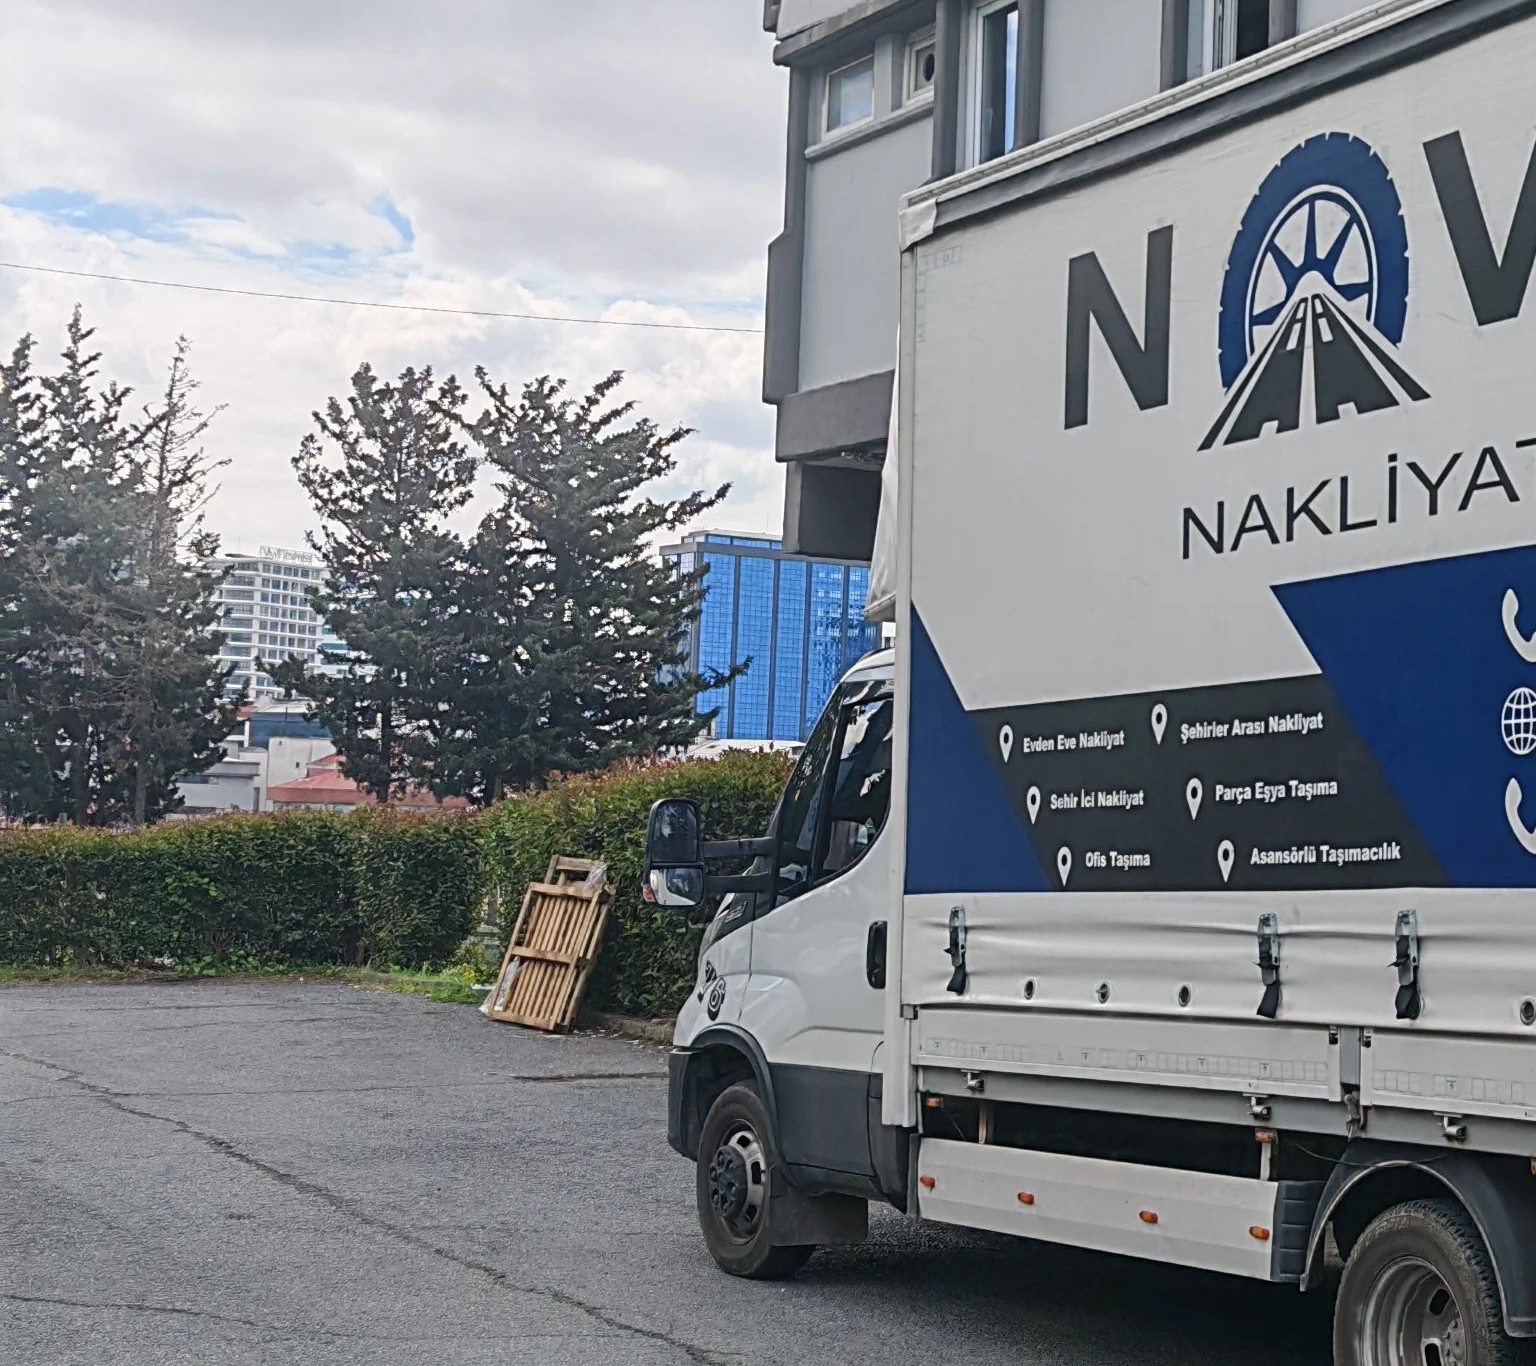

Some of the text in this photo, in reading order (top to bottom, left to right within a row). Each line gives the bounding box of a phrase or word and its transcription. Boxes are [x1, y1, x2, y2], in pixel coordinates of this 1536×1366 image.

[1180, 711, 1323, 744] Şehirler Arası Nakliyat
[1023, 730, 1124, 753] Evden Eve Nakliyat
[1097, 789, 1144, 810] Nakliyat
[1215, 780, 1338, 804] Parça Eşya Taşıma
[1085, 851, 1150, 870] Ofis Taşıma
[1250, 841, 1401, 866] Asansörlü Taşımacılık
